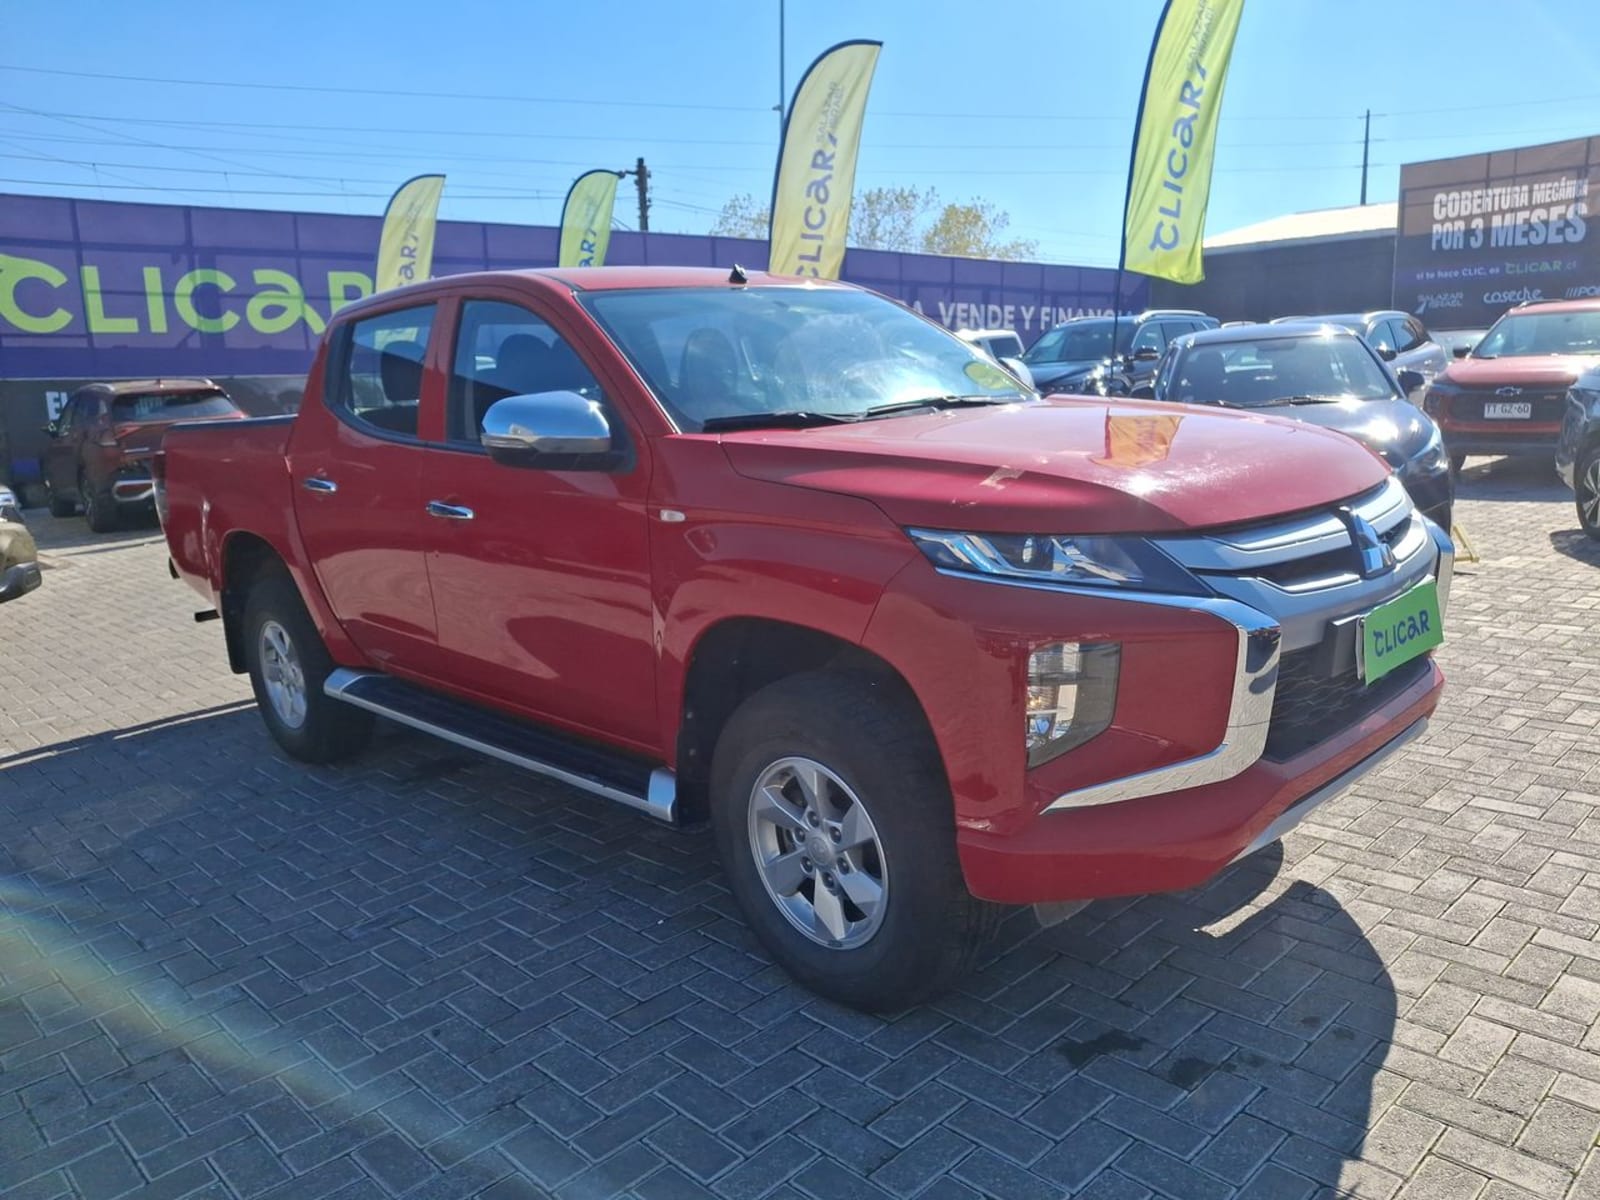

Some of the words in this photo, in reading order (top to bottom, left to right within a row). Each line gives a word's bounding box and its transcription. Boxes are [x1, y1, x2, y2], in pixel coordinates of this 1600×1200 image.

[1432, 185, 1529, 221] COBERTURA
[1532, 176, 1589, 205] MECÁNICA
[1431, 221, 1466, 251] POR
[1470, 218, 1484, 248] 3
[1490, 202, 1588, 248] MESES
[938, 302, 1015, 331] VENDE
[1020, 305, 1035, 331] Y
